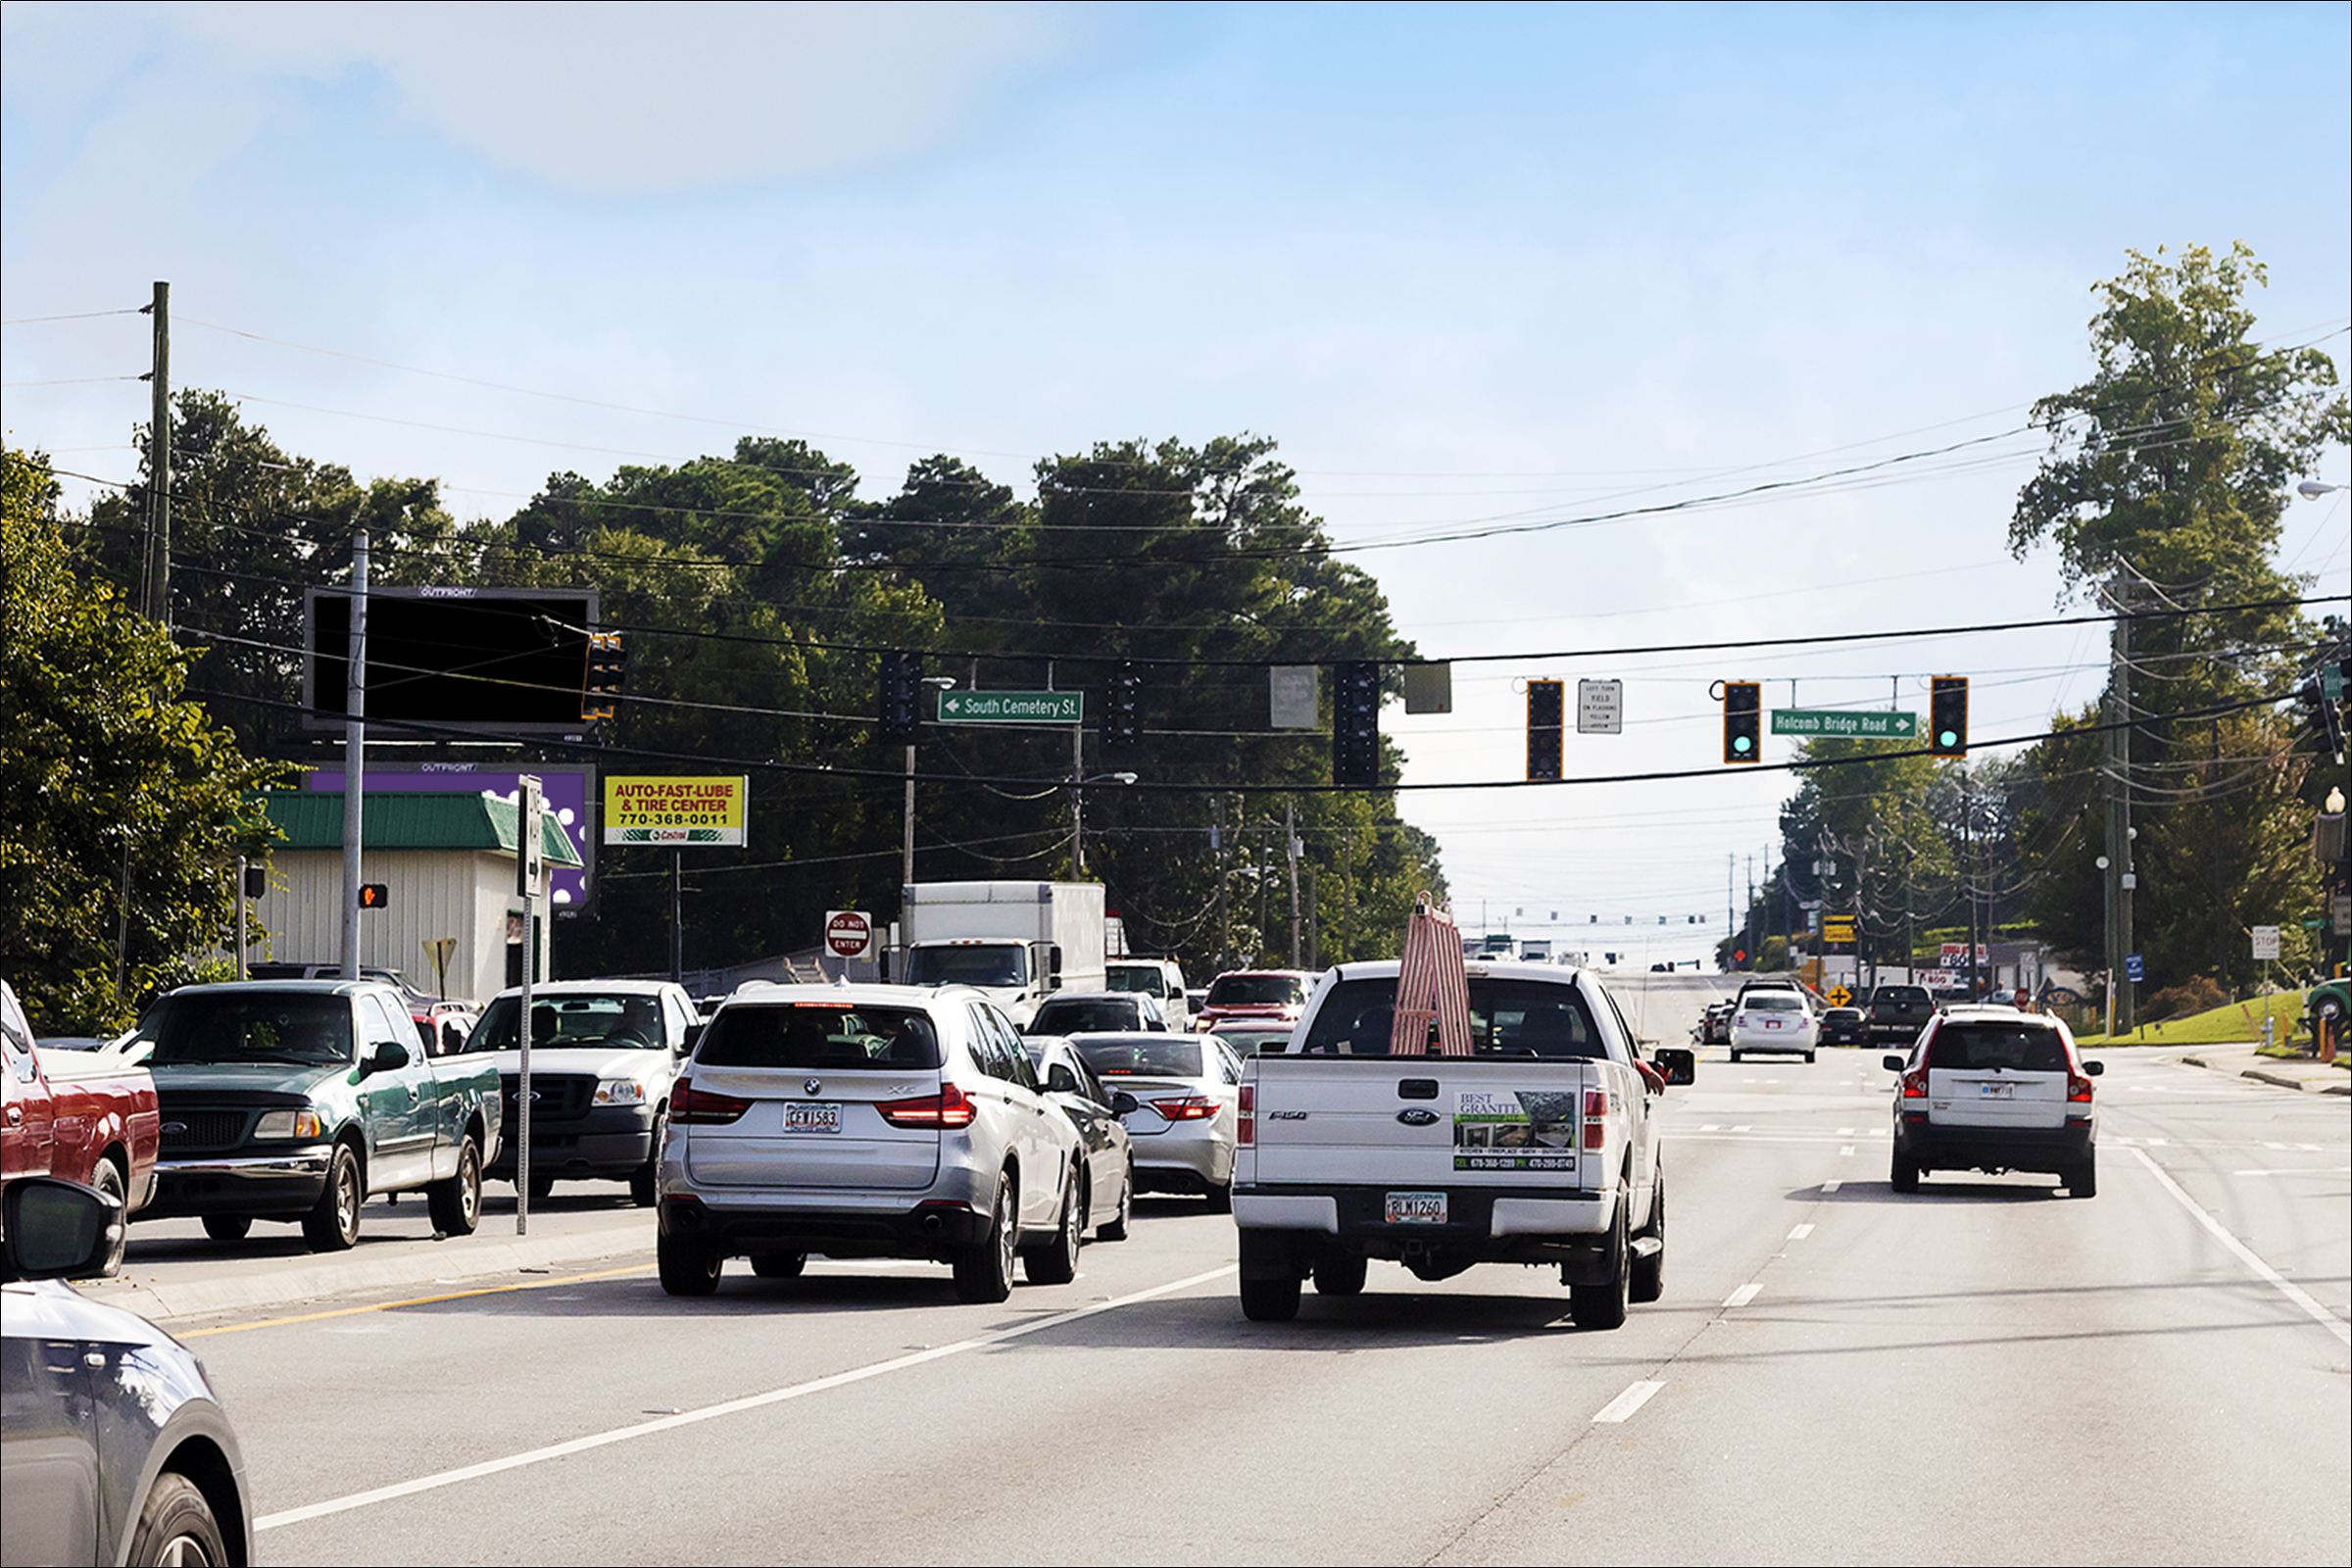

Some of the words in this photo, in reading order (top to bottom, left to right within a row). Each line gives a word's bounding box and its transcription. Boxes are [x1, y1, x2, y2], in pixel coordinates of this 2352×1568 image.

[964, 698, 1000, 714] South
[1002, 698, 1059, 718] Cemetery
[1776, 715, 1821, 730] Holcomb
[1824, 715, 1858, 735] Bridge
[1862, 716, 1887, 732] Road
[614, 784, 734, 798] AUTO-FAST-LUBE
[621, 799, 632, 811] &
[636, 799, 667, 811] TIRE
[670, 799, 727, 811] CENTER
[618, 813, 727, 825] 770-368-0011
[660, 830, 687, 841] Castrol
[833, 919, 845, 928] DO
[848, 920, 864, 929] NOT
[835, 940, 861, 950] ENTER
[2255, 936, 2278, 947] STOP
[1460, 1093, 1494, 1103] BEST
[1459, 1102, 1521, 1114] GRANITE
